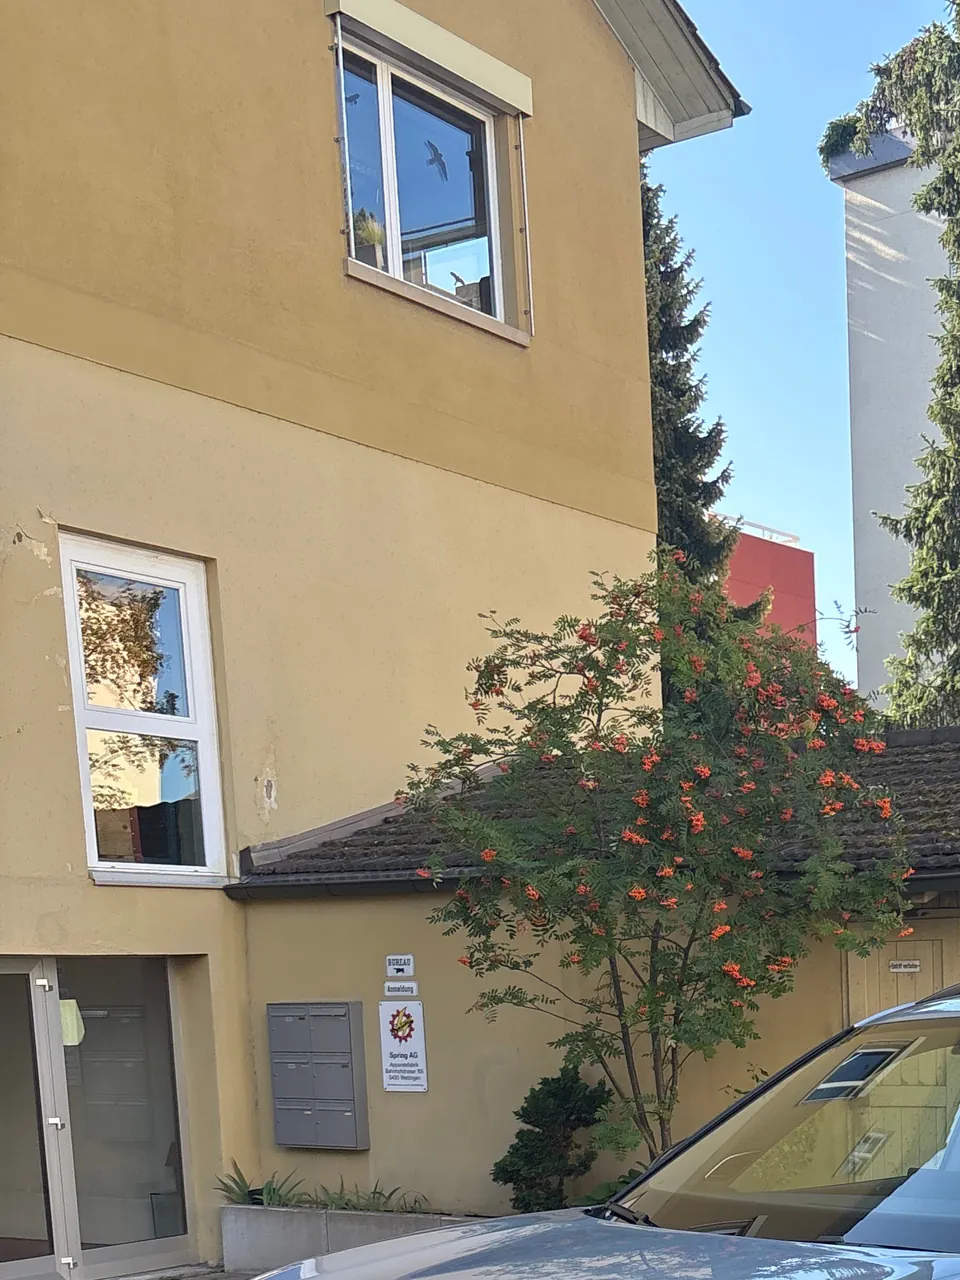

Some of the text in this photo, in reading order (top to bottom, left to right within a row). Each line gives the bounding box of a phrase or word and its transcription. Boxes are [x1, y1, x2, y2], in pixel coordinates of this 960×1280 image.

[387, 958, 411, 967] BUREAU
[387, 985, 414, 994] Anmeldung
[389, 1051, 418, 1060] Spring AG
